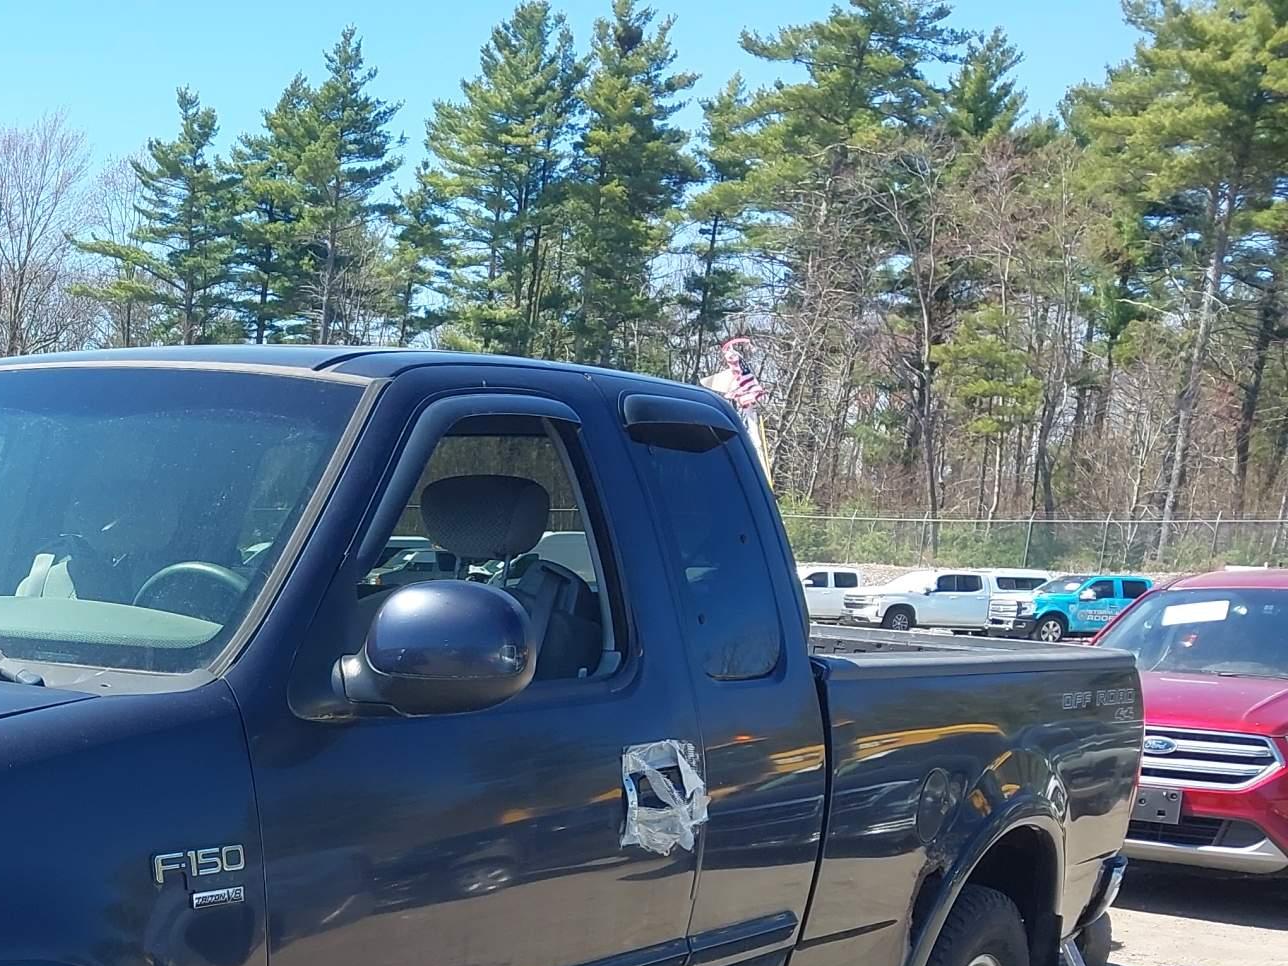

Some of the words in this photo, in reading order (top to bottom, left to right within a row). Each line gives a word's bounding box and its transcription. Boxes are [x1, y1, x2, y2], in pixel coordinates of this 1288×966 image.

[1063, 691, 1092, 710] OFF
[1096, 688, 1136, 706] ROAD
[154, 844, 246, 884] F-150
[194, 892, 226, 906] TRITON
[226, 888, 243, 903] V8
